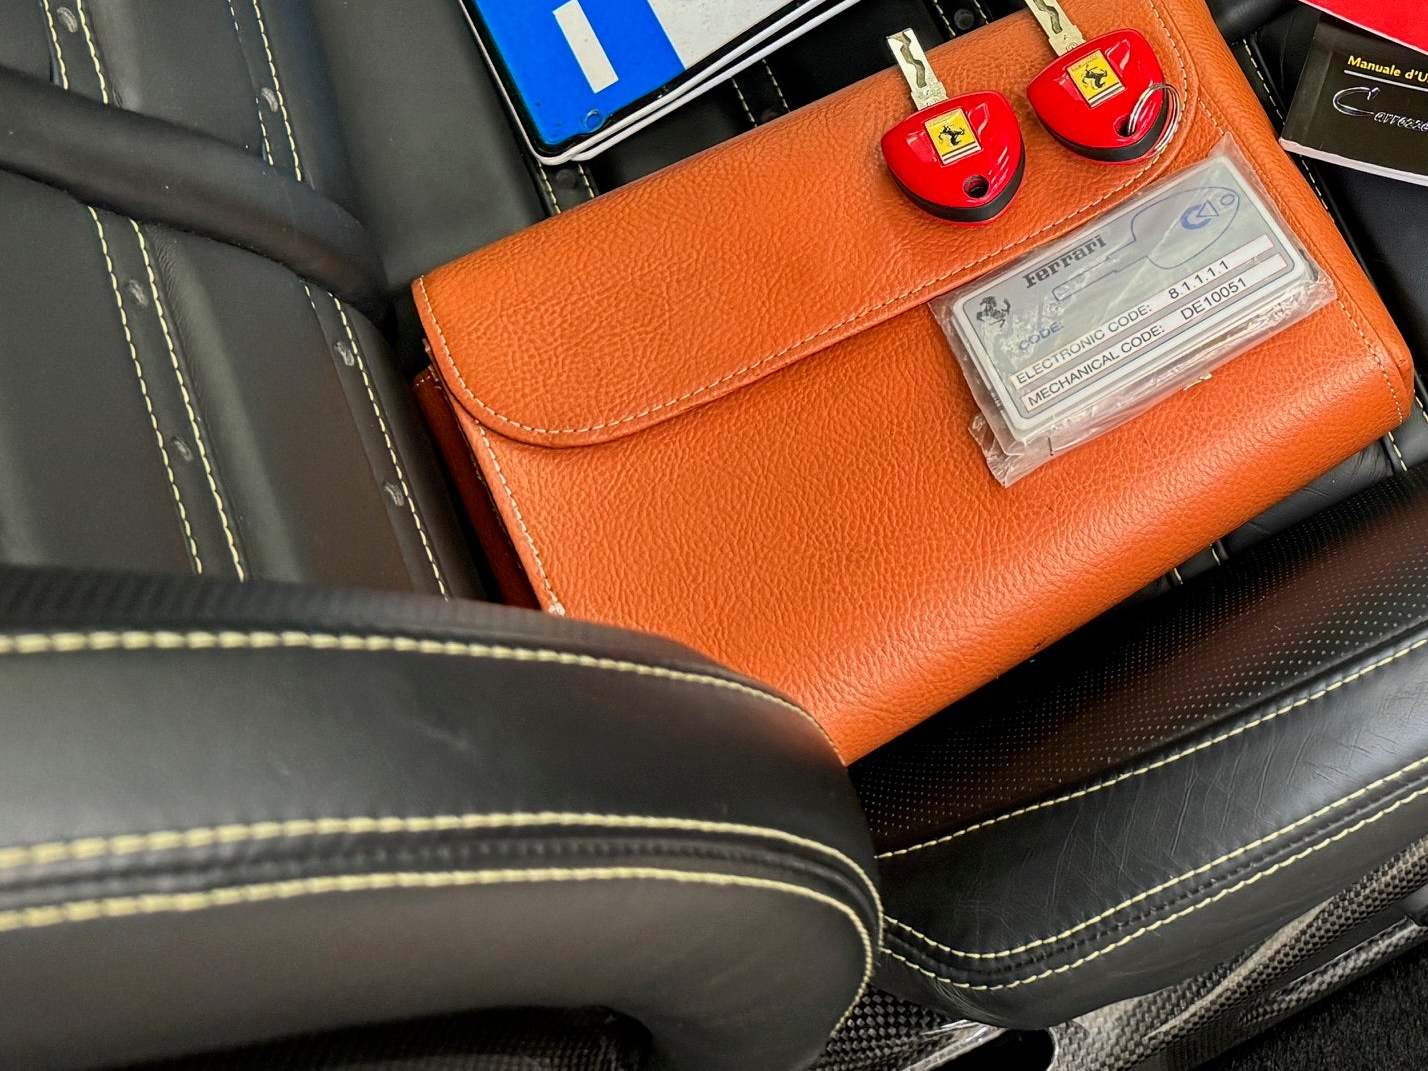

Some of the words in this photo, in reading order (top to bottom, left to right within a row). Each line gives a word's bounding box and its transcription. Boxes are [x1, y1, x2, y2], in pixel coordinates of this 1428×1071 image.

[1347, 54, 1402, 78] Manuale
[1022, 234, 1107, 289] Ferrari
[1016, 330, 1105, 385] ELECTRONIC
[1107, 304, 1153, 334] CODE:
[1017, 320, 1065, 352] CODE:
[1028, 350, 1121, 407] MECHANICAL
[1120, 323, 1166, 353] CODE:
[1180, 277, 1249, 321] DE10051
